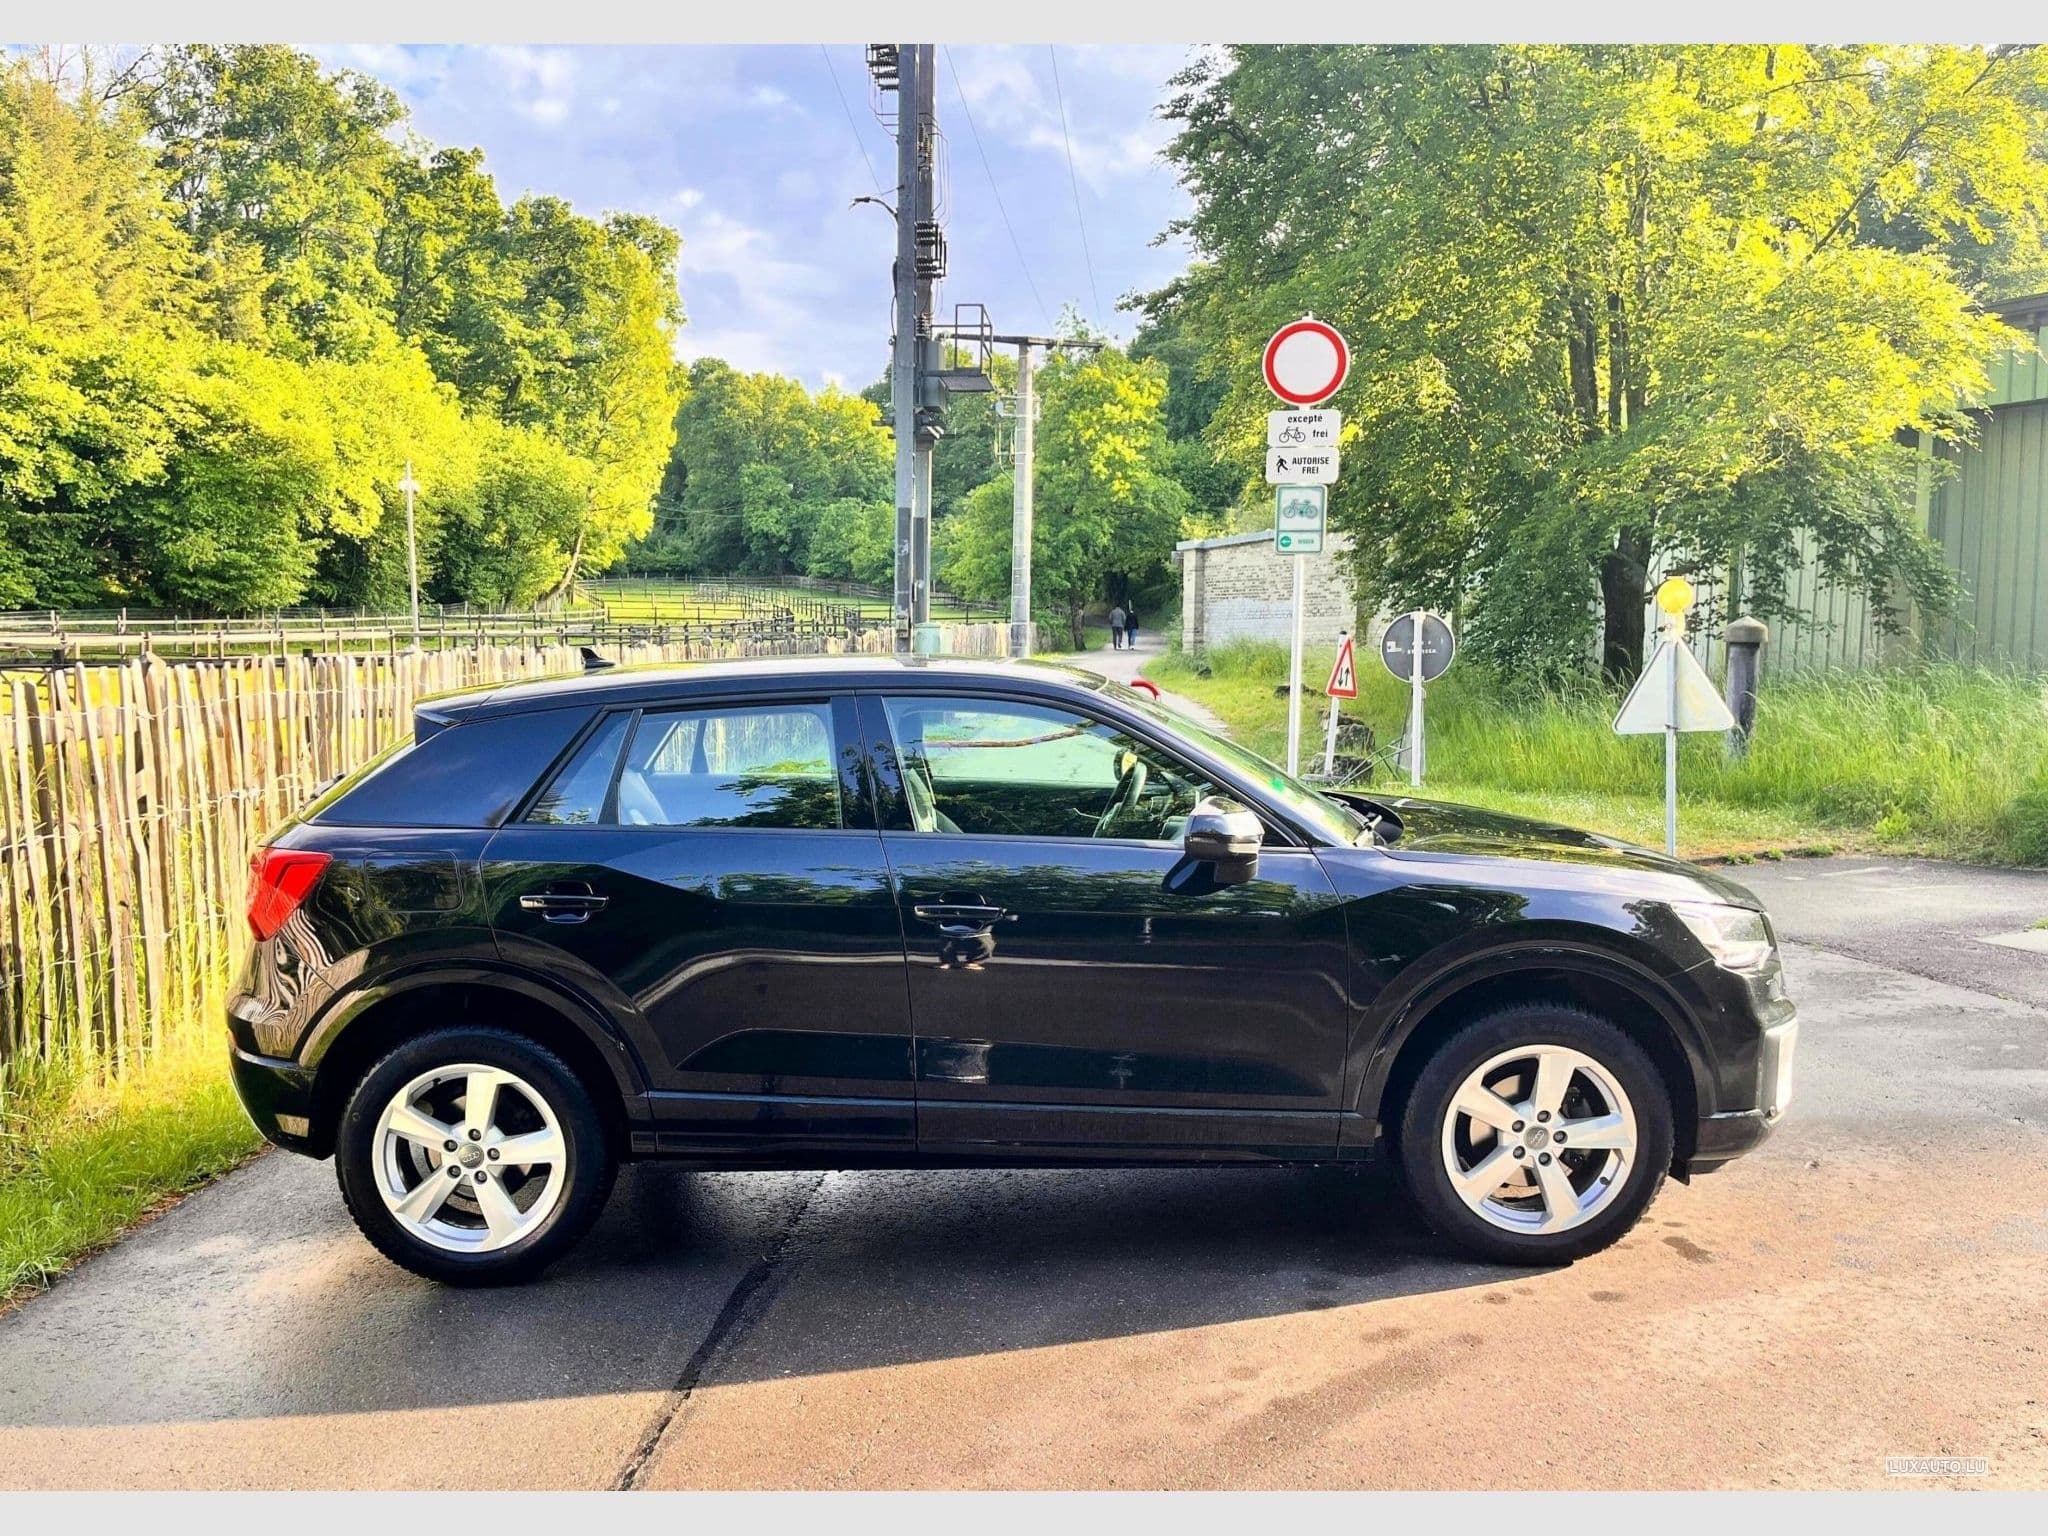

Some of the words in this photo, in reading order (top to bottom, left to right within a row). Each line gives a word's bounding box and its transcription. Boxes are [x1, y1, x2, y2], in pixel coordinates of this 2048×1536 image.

[1287, 414, 1323, 424] excepté
[1312, 429, 1328, 438] frei
[1292, 457, 1329, 465] AUTORISE
[1302, 466, 1319, 474] FREI
